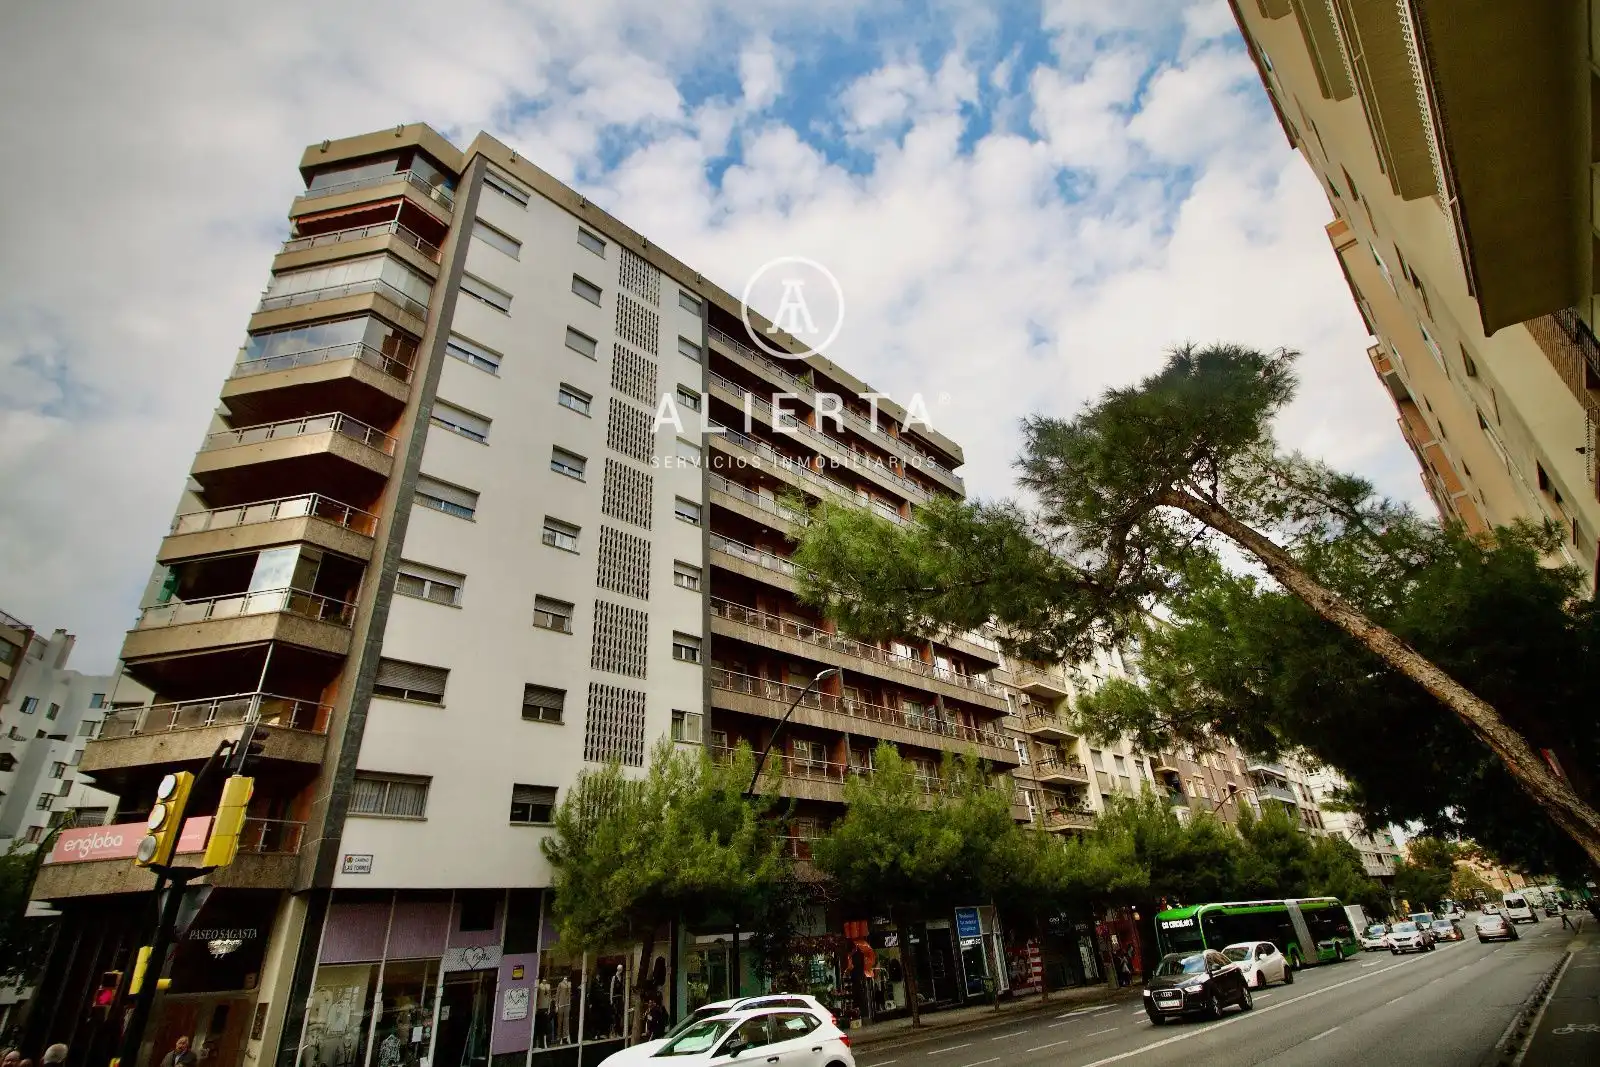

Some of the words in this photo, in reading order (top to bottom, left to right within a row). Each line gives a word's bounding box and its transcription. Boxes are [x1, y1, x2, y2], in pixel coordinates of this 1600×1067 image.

[63, 833, 123, 858] engloba
[189, 929, 219, 940] PASEO
[219, 928, 257, 939] SAGASTA
